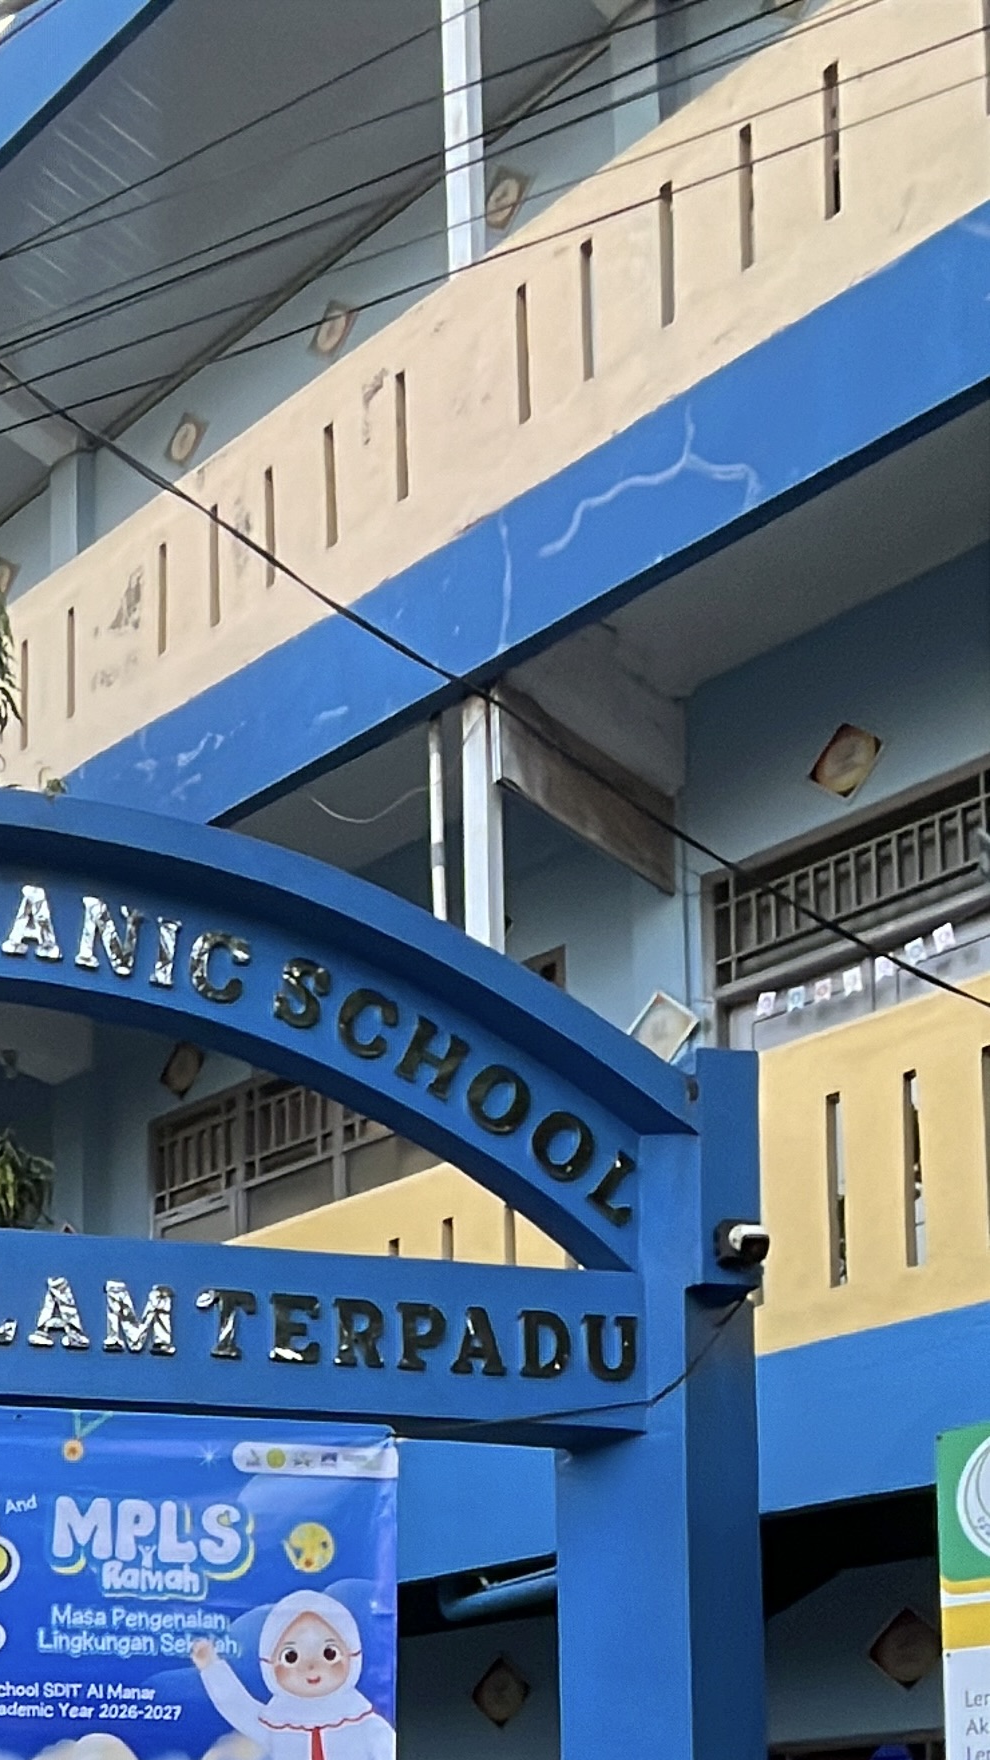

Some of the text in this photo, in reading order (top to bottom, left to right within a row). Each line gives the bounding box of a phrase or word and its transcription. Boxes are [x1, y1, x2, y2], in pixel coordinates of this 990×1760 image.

[273, 956, 640, 1229] SCHOOL
[195, 1288, 639, 1383] TERPADU
[5, 1494, 38, 1515] And
[52, 1495, 242, 1565] MPLS
[51, 1602, 226, 1631] Masa Pengenalan
[37, 1627, 238, 1655] Lingkungan Sekah
[43, 1682, 82, 1698] SDIT
[86, 1683, 103, 1700] Al
[107, 1683, 156, 1701] Manar
[58, 1702, 95, 1719] Year
[98, 1703, 182, 1721] 2026-2027
